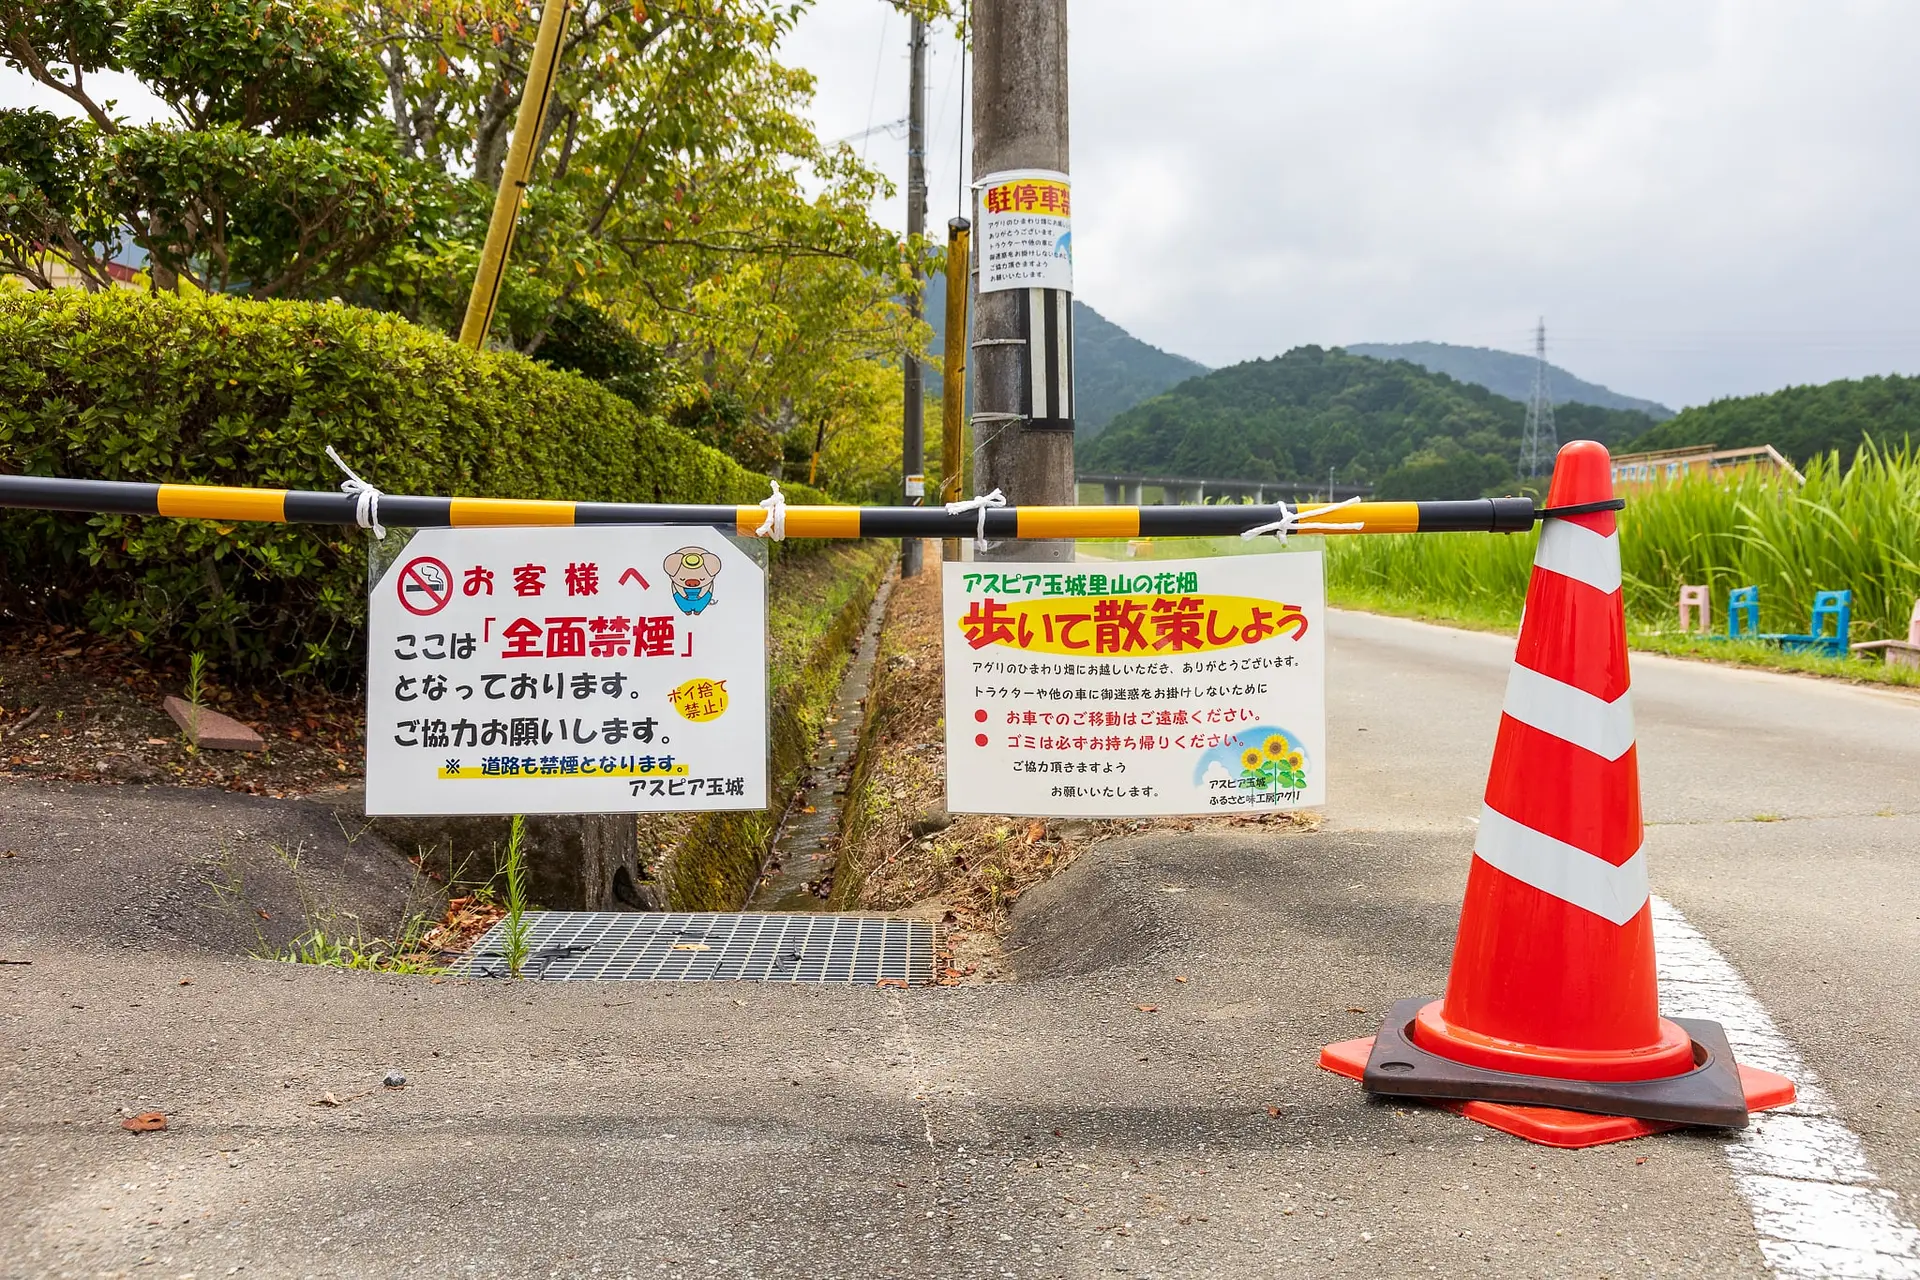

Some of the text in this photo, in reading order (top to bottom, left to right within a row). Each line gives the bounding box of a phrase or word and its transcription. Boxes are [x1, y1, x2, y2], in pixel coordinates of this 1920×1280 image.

[462, 562, 650, 598] お客様へ
[963, 571, 1198, 597] アスピア玉城里山の花畑
[963, 597, 1309, 654] 歩いて散策しよう
[394, 615, 694, 661] ここは「全面禁煙」
[394, 672, 640, 701] となっております。
[667, 680, 727, 703] ポイ捨て
[974, 682, 1268, 701] トラクターや他の車に御迷惑をお掛けしないために
[1006, 707, 1261, 727] お車でのご移動はご遠慮ください。
[394, 716, 671, 748] ご協力お願いします。
[1007, 732, 1245, 751] ゴミは必ずお持ち帰りください。
[481, 755, 685, 776] 道路も禁煙となります。
[1012, 760, 1127, 775] ご協力頂きますよう
[628, 777, 744, 797] アスピア玉城
[1051, 785, 1160, 798] お願いいたします。
[1209, 790, 1301, 806] ふるさと味工房アグリ
